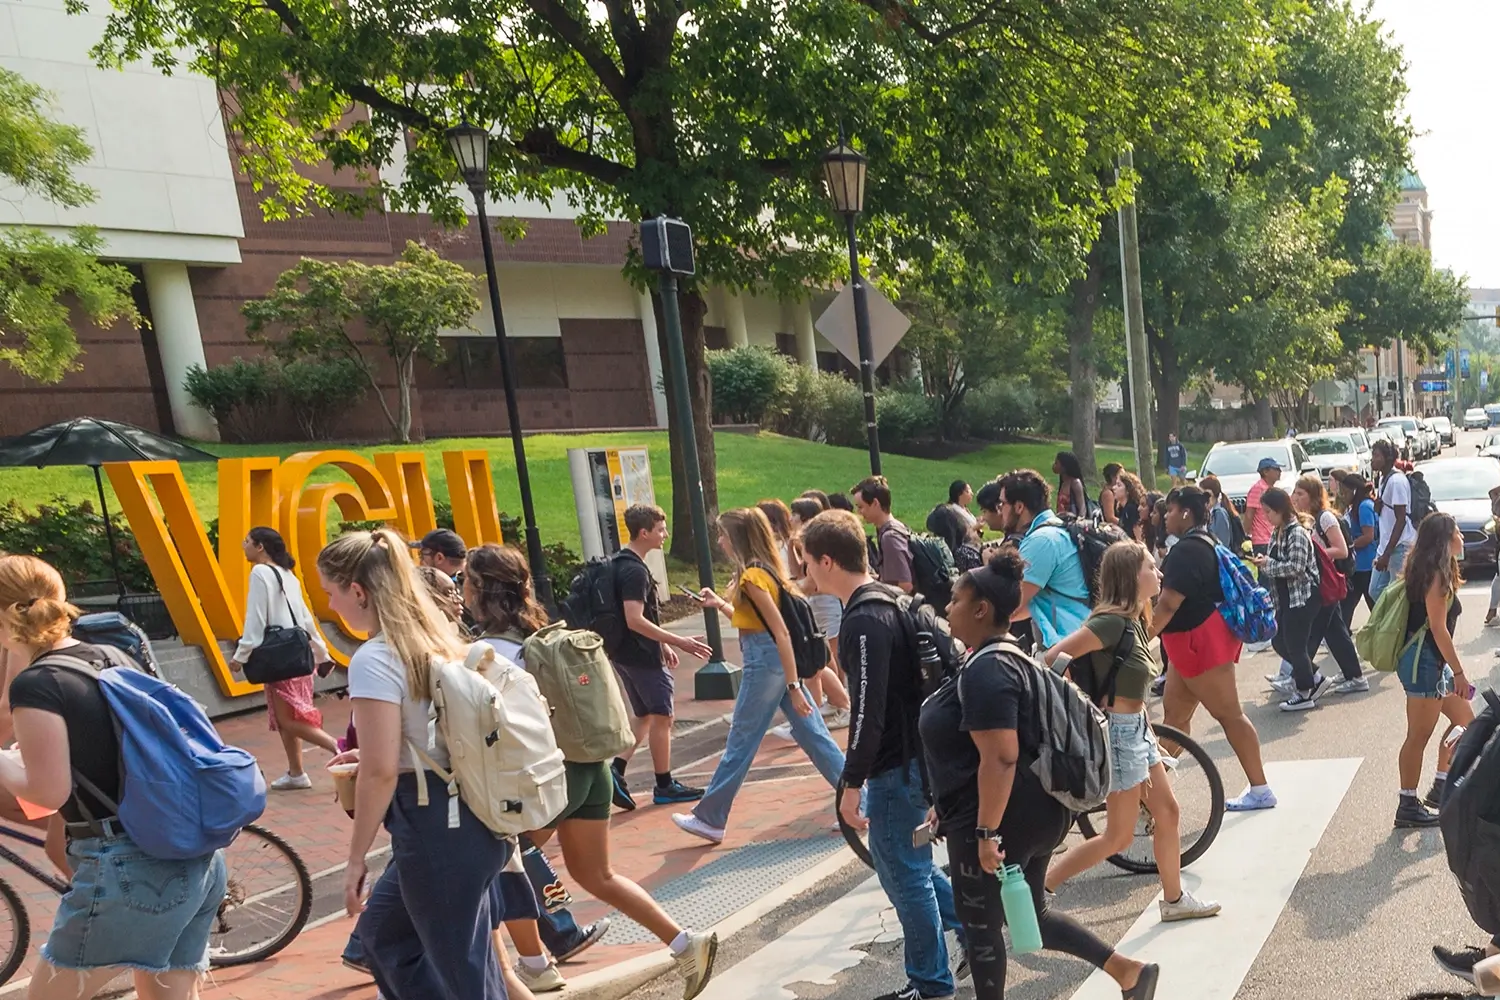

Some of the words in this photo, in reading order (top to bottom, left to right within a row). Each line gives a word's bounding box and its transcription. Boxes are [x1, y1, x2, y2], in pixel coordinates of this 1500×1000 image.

[860, 635, 868, 665] Electrical
[859, 680, 867, 713] Computer
[850, 714, 865, 750] Engineering
[960, 862, 996, 962] NIKE
